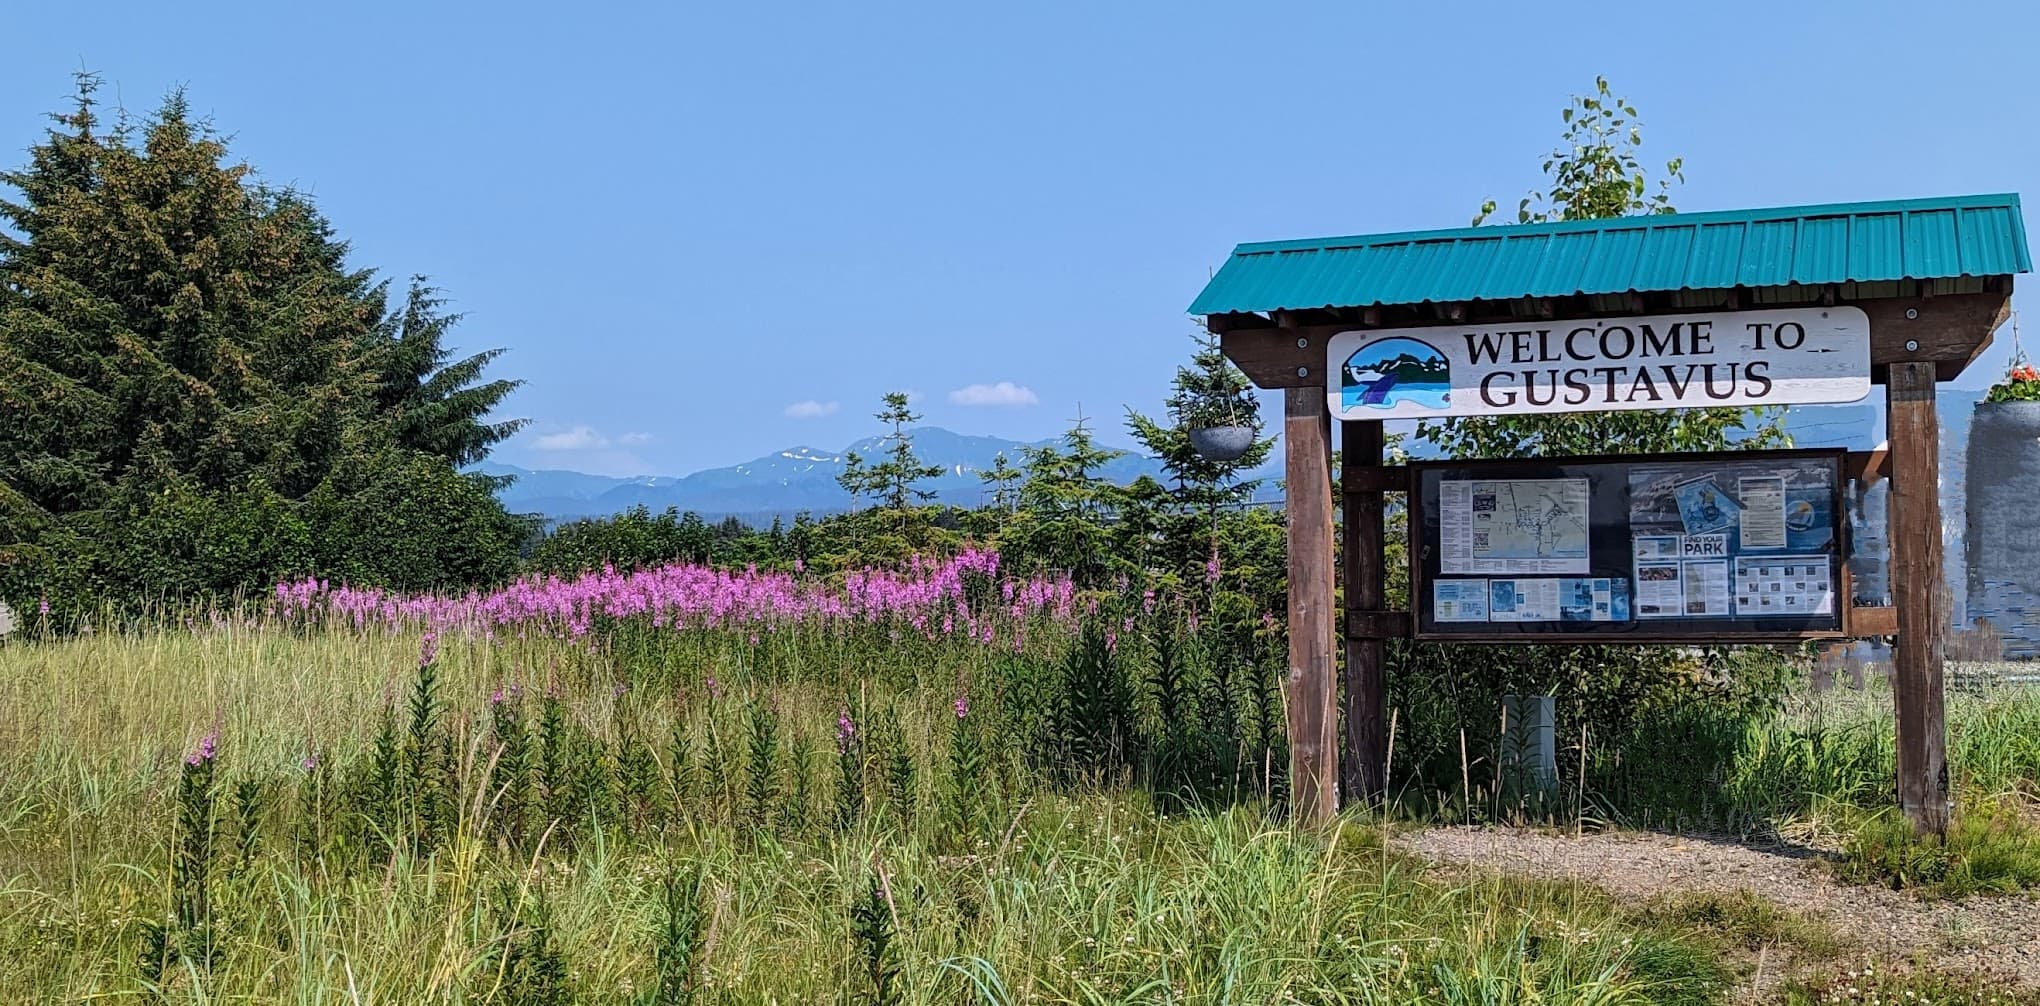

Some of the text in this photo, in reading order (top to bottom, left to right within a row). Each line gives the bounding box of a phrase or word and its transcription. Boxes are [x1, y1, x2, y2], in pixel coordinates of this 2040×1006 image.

[1463, 321, 1805, 365] WELCOME TO
[1480, 361, 1772, 408] GUSTAVUS
[1685, 543, 1723, 555] PARK
